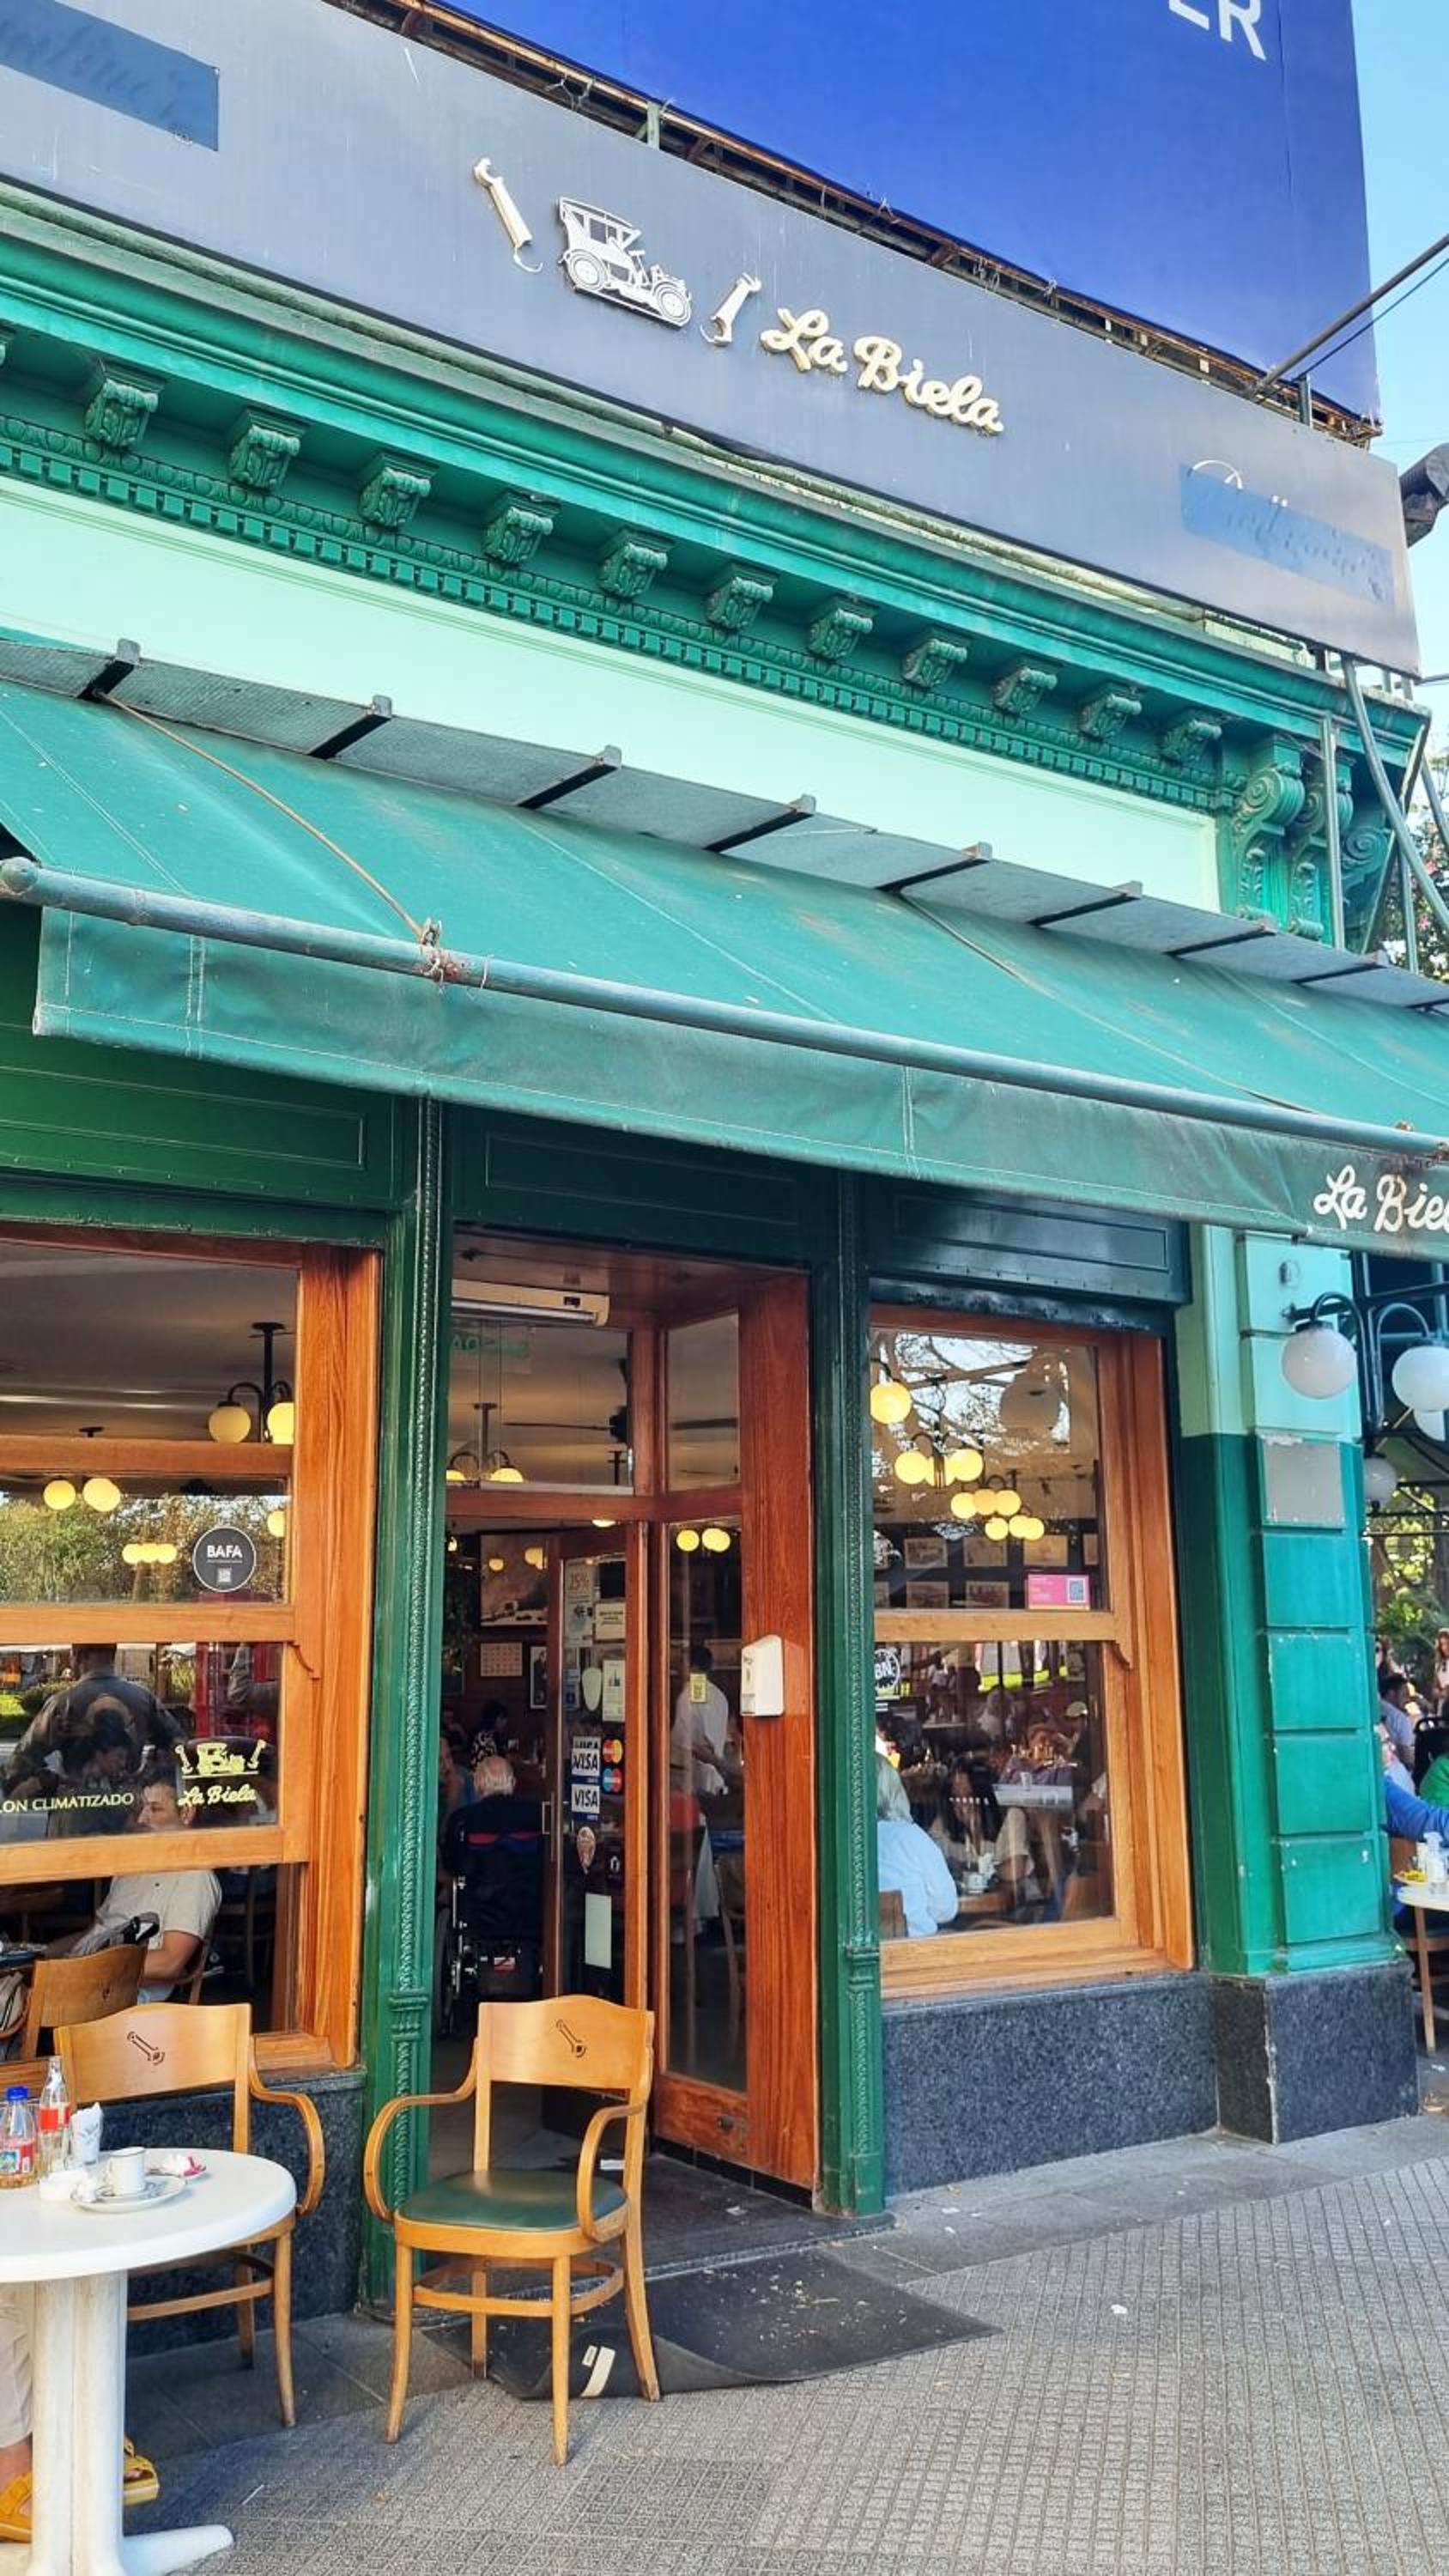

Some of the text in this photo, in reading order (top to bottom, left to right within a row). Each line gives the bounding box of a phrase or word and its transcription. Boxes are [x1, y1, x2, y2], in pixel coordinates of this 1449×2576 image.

[1169, 0, 1267, 61] R
[760, 307, 1004, 435] La Biela
[1313, 1164, 1367, 1230] La
[207, 1545, 243, 1558] BAFA
[573, 1753, 598, 1771] VISA
[32, 1792, 135, 1811] CLIMATIZADO
[178, 1783, 257, 1807] La Biela
[573, 1789, 598, 1807] VISA
